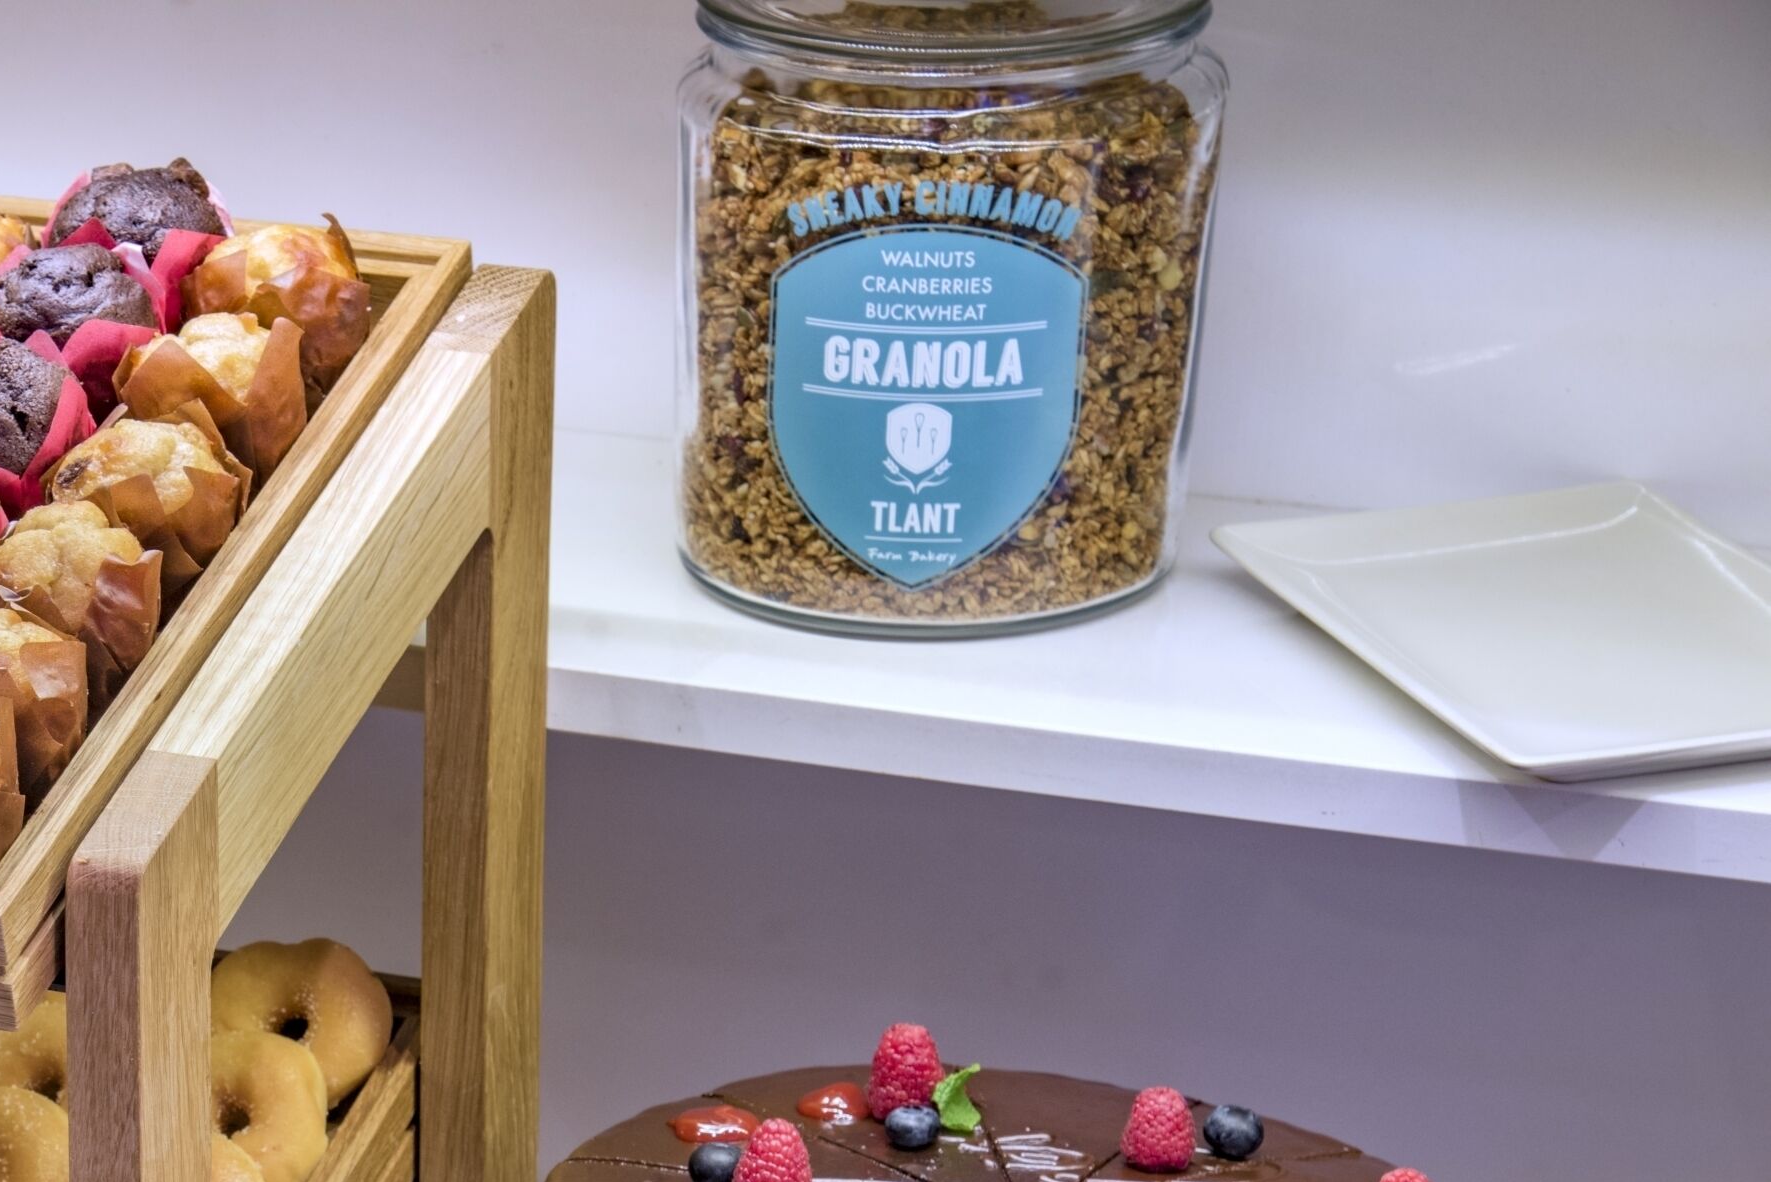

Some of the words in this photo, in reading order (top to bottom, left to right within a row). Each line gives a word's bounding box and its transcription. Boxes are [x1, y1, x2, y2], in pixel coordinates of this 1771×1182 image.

[786, 181, 903, 238] SNEAKY
[914, 180, 1083, 242] CINNAMON
[880, 249, 977, 269] WALNUTS
[861, 275, 994, 296] CRANBERRIES
[864, 302, 988, 322] BUCKWHEAT
[821, 334, 1025, 390] GRANOLA
[870, 500, 962, 534] TLANT
[866, 546, 903, 563] Farm
[908, 550, 958, 566] Bakery
